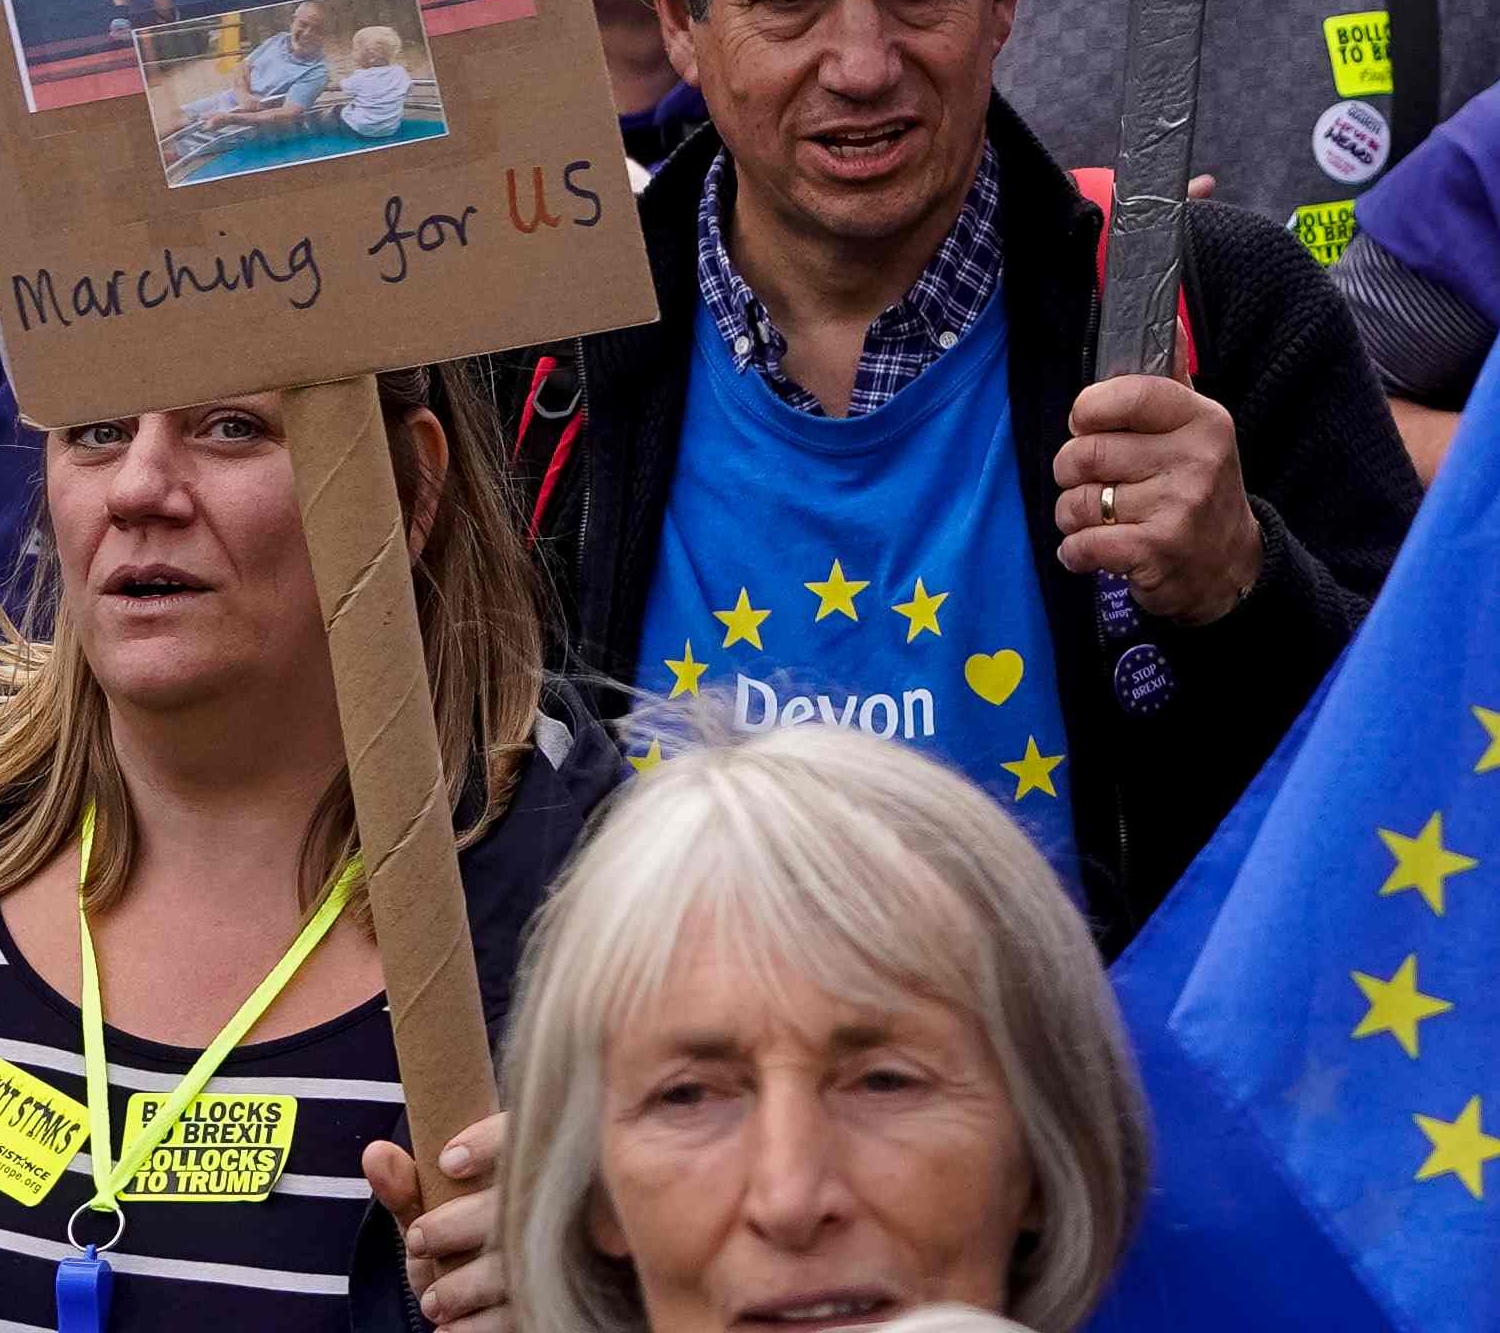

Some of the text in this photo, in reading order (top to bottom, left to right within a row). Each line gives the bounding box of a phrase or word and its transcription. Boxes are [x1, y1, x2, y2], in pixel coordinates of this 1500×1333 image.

[13, 233, 321, 332] Marching
[369, 197, 479, 284] for
[1131, 663, 1157, 684] STOP
[1131, 673, 1168, 700] BREXIT
[142, 1101, 282, 1124] BLLOCKS
[8, 1095, 81, 1156] STINKS
[183, 1123, 278, 1144] BREXIT
[135, 1171, 271, 1193] TO TRUMP
